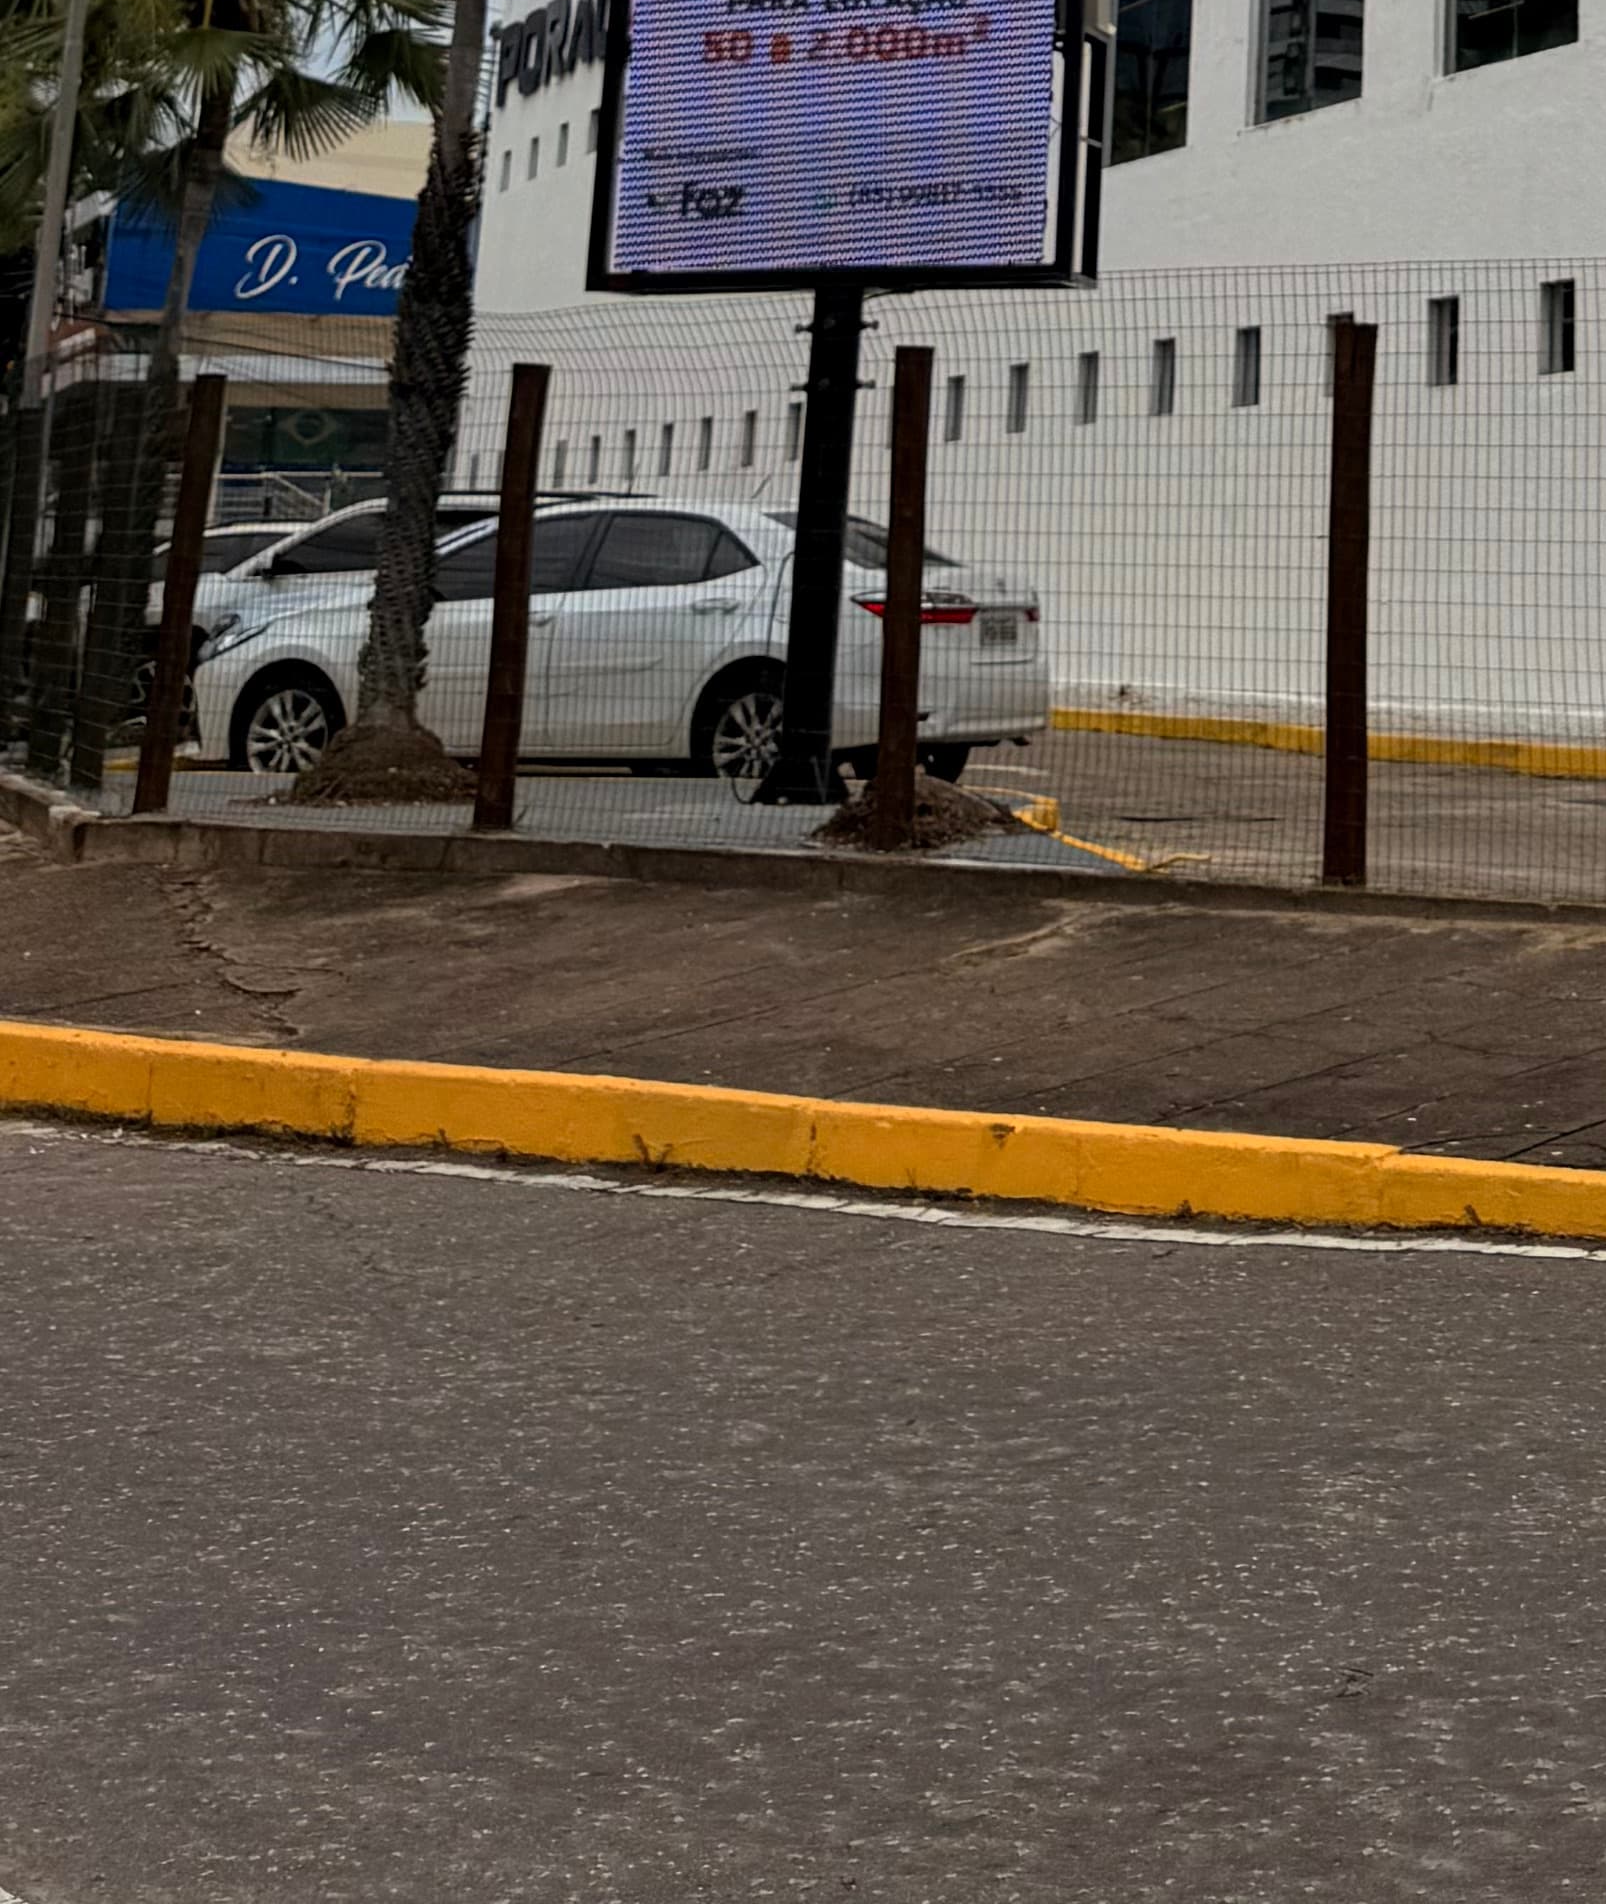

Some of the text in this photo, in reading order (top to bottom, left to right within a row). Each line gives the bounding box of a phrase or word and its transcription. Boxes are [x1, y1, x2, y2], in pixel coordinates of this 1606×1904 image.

[702, 29, 753, 64] 50
[770, 33, 791, 64] a
[234, 234, 298, 299] D.
